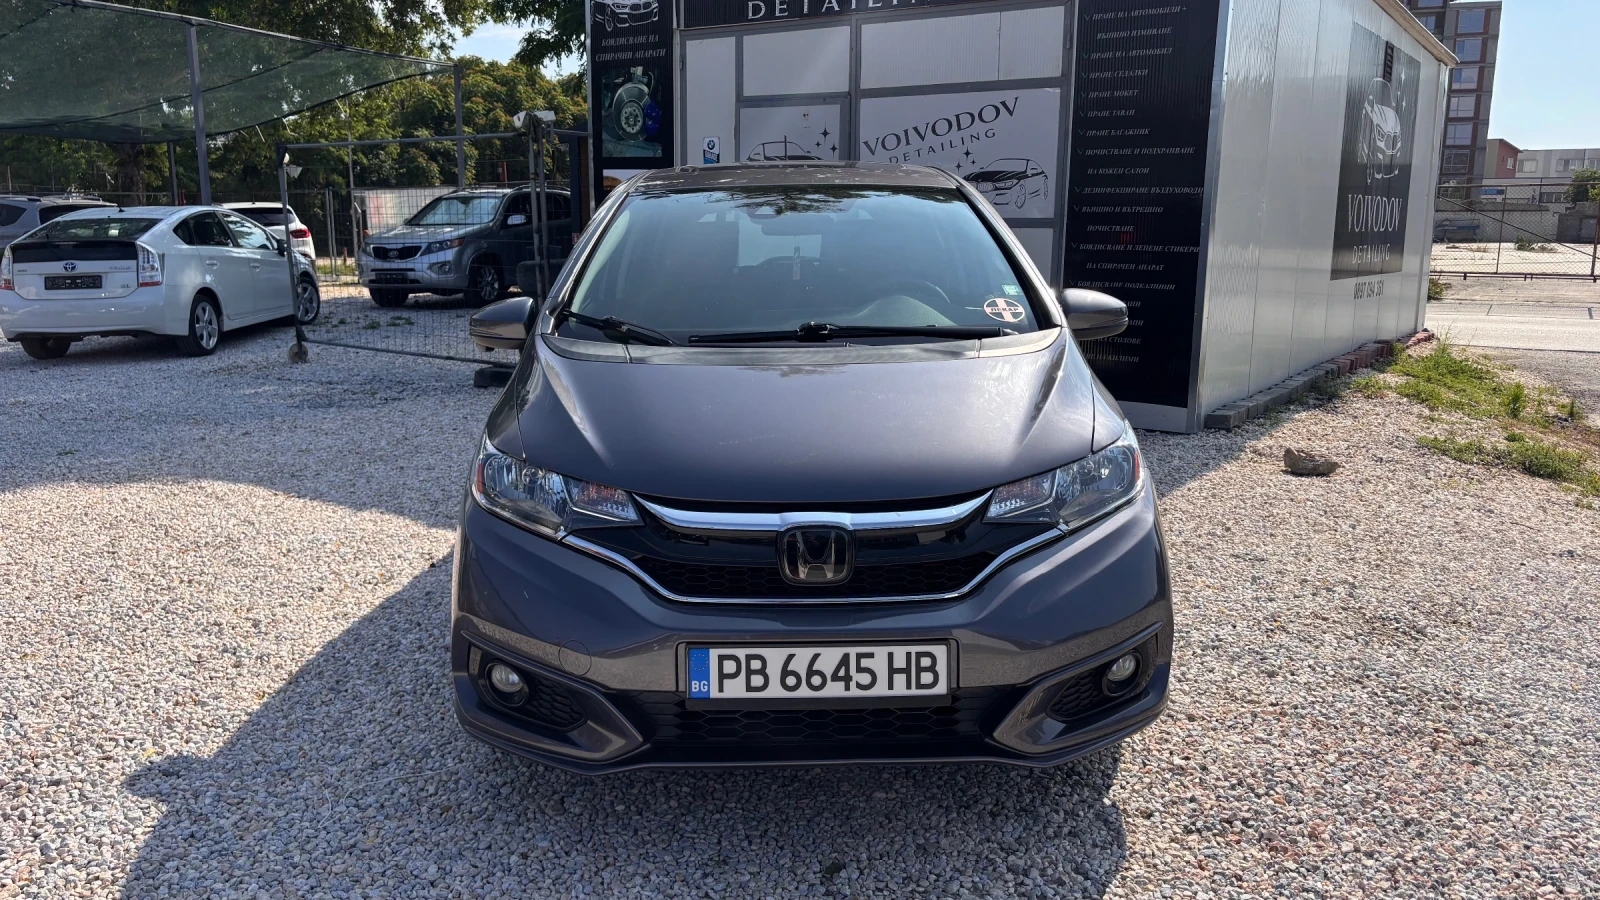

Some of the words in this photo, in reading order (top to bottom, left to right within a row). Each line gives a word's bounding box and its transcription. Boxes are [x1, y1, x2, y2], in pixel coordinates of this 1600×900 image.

[1092, 11, 1117, 21] ПРАНЕ
[1117, 10, 1127, 18] НА
[1128, 5, 1181, 17] АВТОМОБИЛИ
[1130, 26, 1173, 37] ИЗМИВАНЕ
[648, 34, 659, 43] НА
[595, 51, 633, 62] СПИРАЧНИ
[633, 48, 667, 59] АПАРАТИ
[1090, 51, 1115, 60] ПРАНЕ
[1115, 50, 1126, 58] НА
[1126, 47, 1173, 57] АВТОМОБИЛ
[1089, 71, 1113, 79] ПРАНЕ
[1088, 90, 1112, 98] ПРАНЕ
[1113, 89, 1139, 97] МОКЕТ
[1087, 110, 1111, 118] ПРАНЕ
[1112, 109, 1136, 117] ТАВАН
[862, 96, 1020, 156] VOIVODOV
[1086, 129, 1110, 137] ПРАНЕ
[1110, 128, 1151, 136] БАГАЖНИК
[888, 128, 996, 164] DETAILING
[1085, 147, 1133, 156] ПОЧИСТВАНЕ
[1140, 146, 1196, 155] ПОДХРАНВАНЕ
[1098, 167, 1124, 175] КОЖЕН
[1124, 167, 1150, 175] САЛОН
[1082, 187, 1150, 195] ДЕЗИНФЕКЦИРАНЕ
[1348, 194, 1403, 233] VOIVODOV
[1086, 225, 1135, 233] ПОЧИСТВАНЕ
[1079, 243, 1126, 251] БОЯДИСВАНЕ
[1133, 244, 1164, 252] ЛЕПЕНЕ
[1352, 243, 1391, 264] DETAILING
[1097, 262, 1136, 270] СПИРАЧЕН
[1136, 263, 1164, 271] АПАРАТ
[1108, 336, 1142, 345] СТОЛОВЕ
[716, 653, 770, 693] PB
[779, 651, 878, 692] 6645
[886, 651, 940, 691] HB
[691, 680, 709, 692] BG
